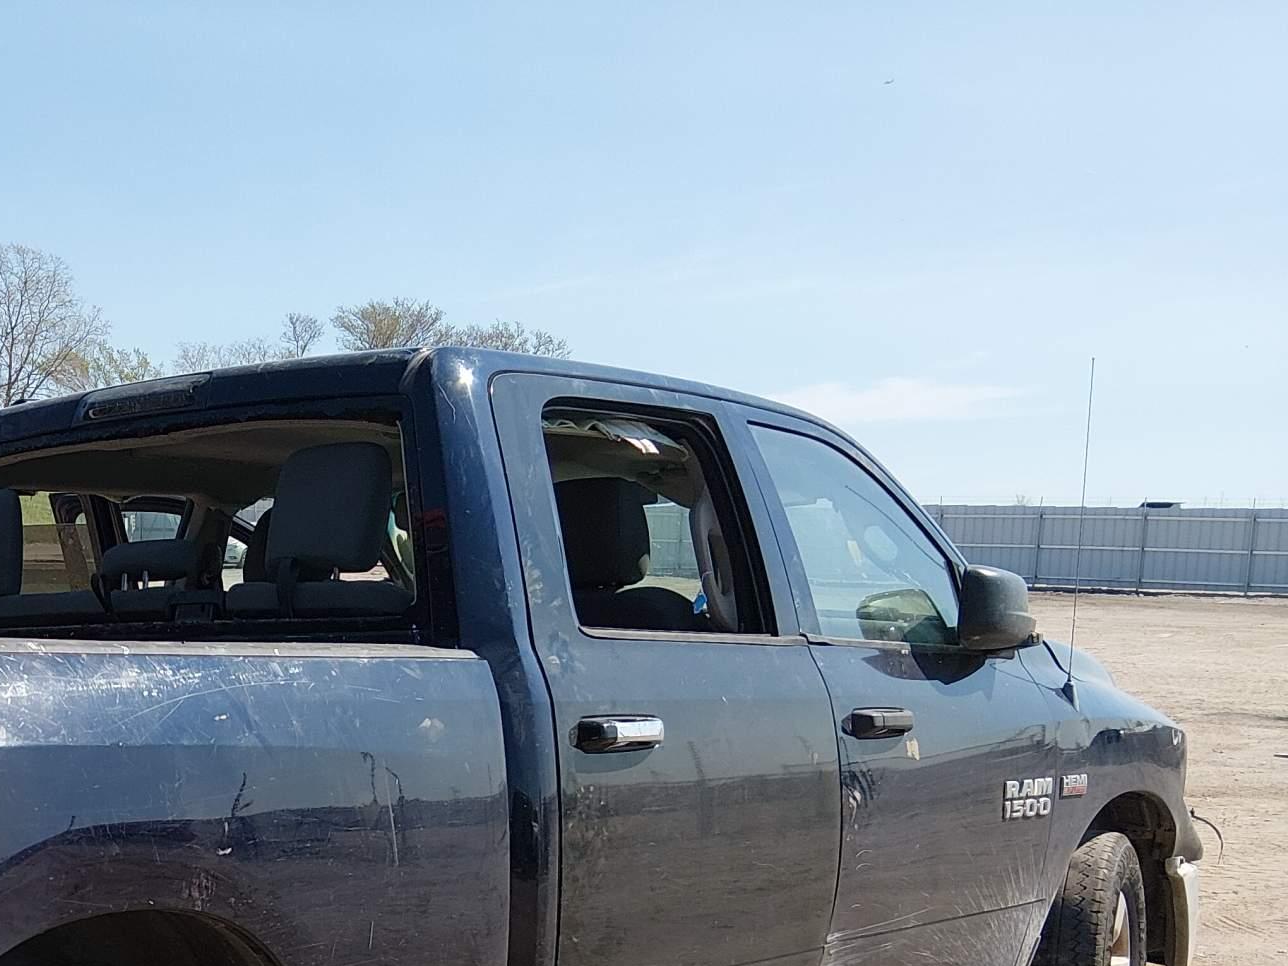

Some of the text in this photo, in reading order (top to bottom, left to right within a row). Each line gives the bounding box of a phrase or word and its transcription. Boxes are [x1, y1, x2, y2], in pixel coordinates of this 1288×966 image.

[1005, 777, 1053, 799] RAM
[1062, 774, 1088, 787] HEMI
[1004, 797, 1051, 819] 1500
